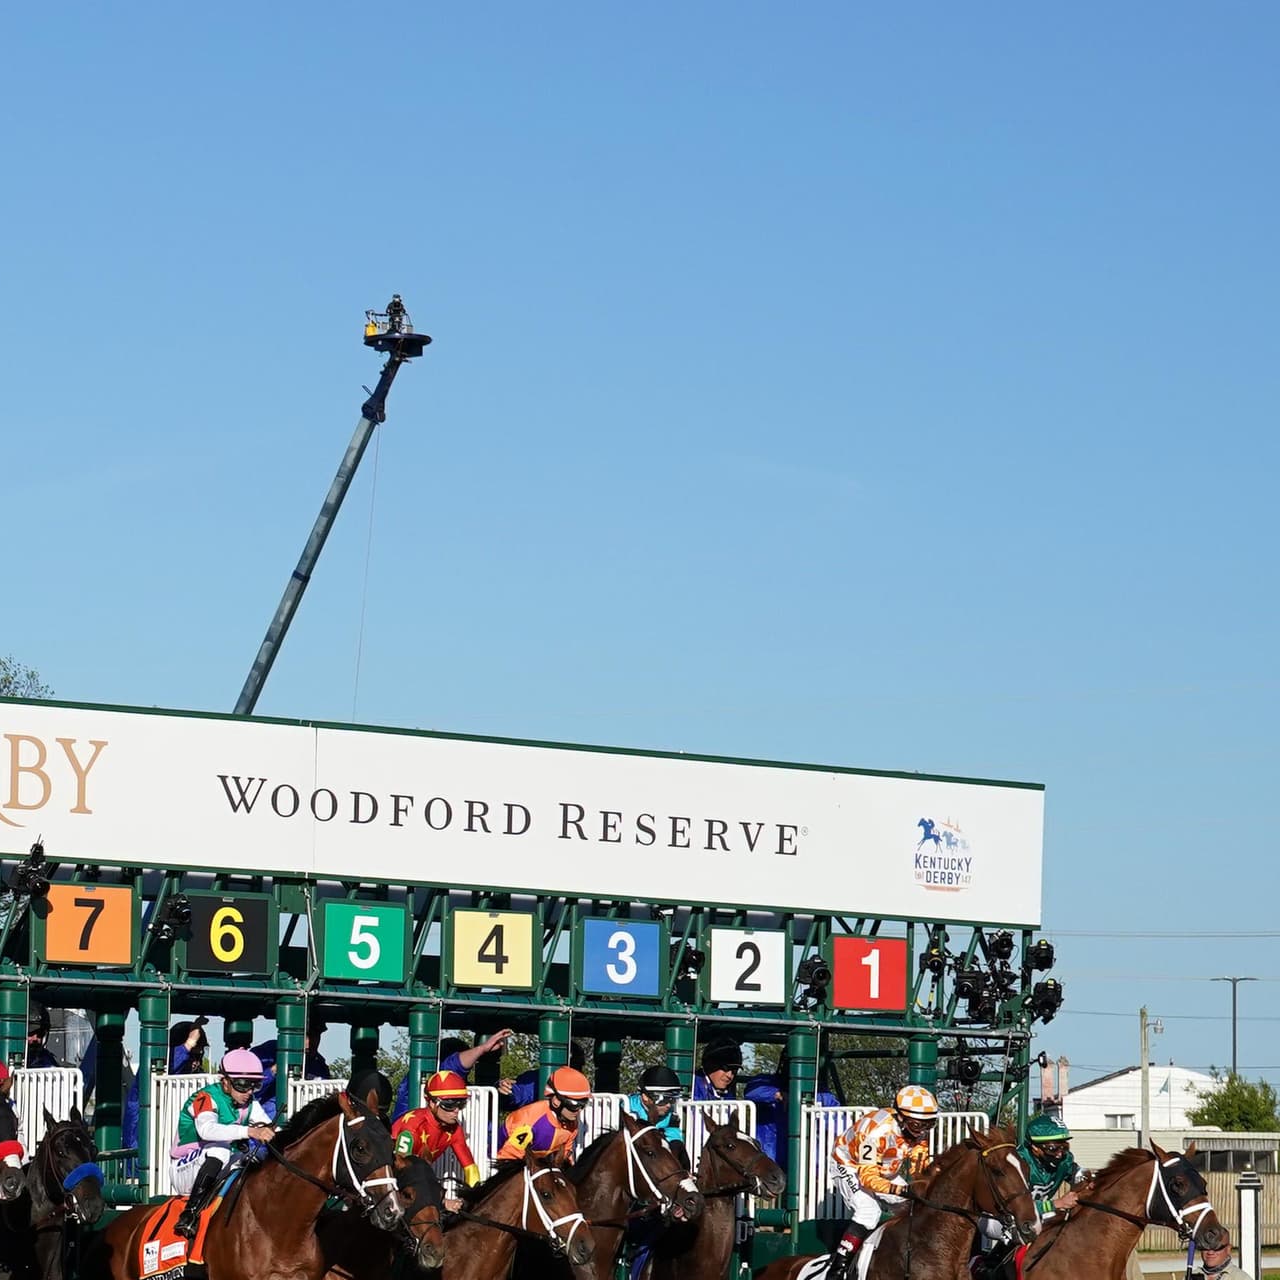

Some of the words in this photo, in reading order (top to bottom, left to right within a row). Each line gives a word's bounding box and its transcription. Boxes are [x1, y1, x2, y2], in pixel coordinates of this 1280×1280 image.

[216, 774, 531, 836] WOODFORD
[915, 853, 972, 873] KENTUCKY
[925, 870, 961, 885] DERBY
[74, 898, 104, 950] 7
[210, 907, 244, 962] 6
[348, 916, 380, 969] 5
[478, 924, 509, 974] 4
[606, 931, 637, 984] 3
[735, 941, 761, 991] 2
[861, 949, 880, 998] 1
[197, 1096, 207, 1112] 7
[398, 1135, 411, 1152] 5
[516, 1132, 528, 1145] 4
[862, 1144, 873, 1161] 2
